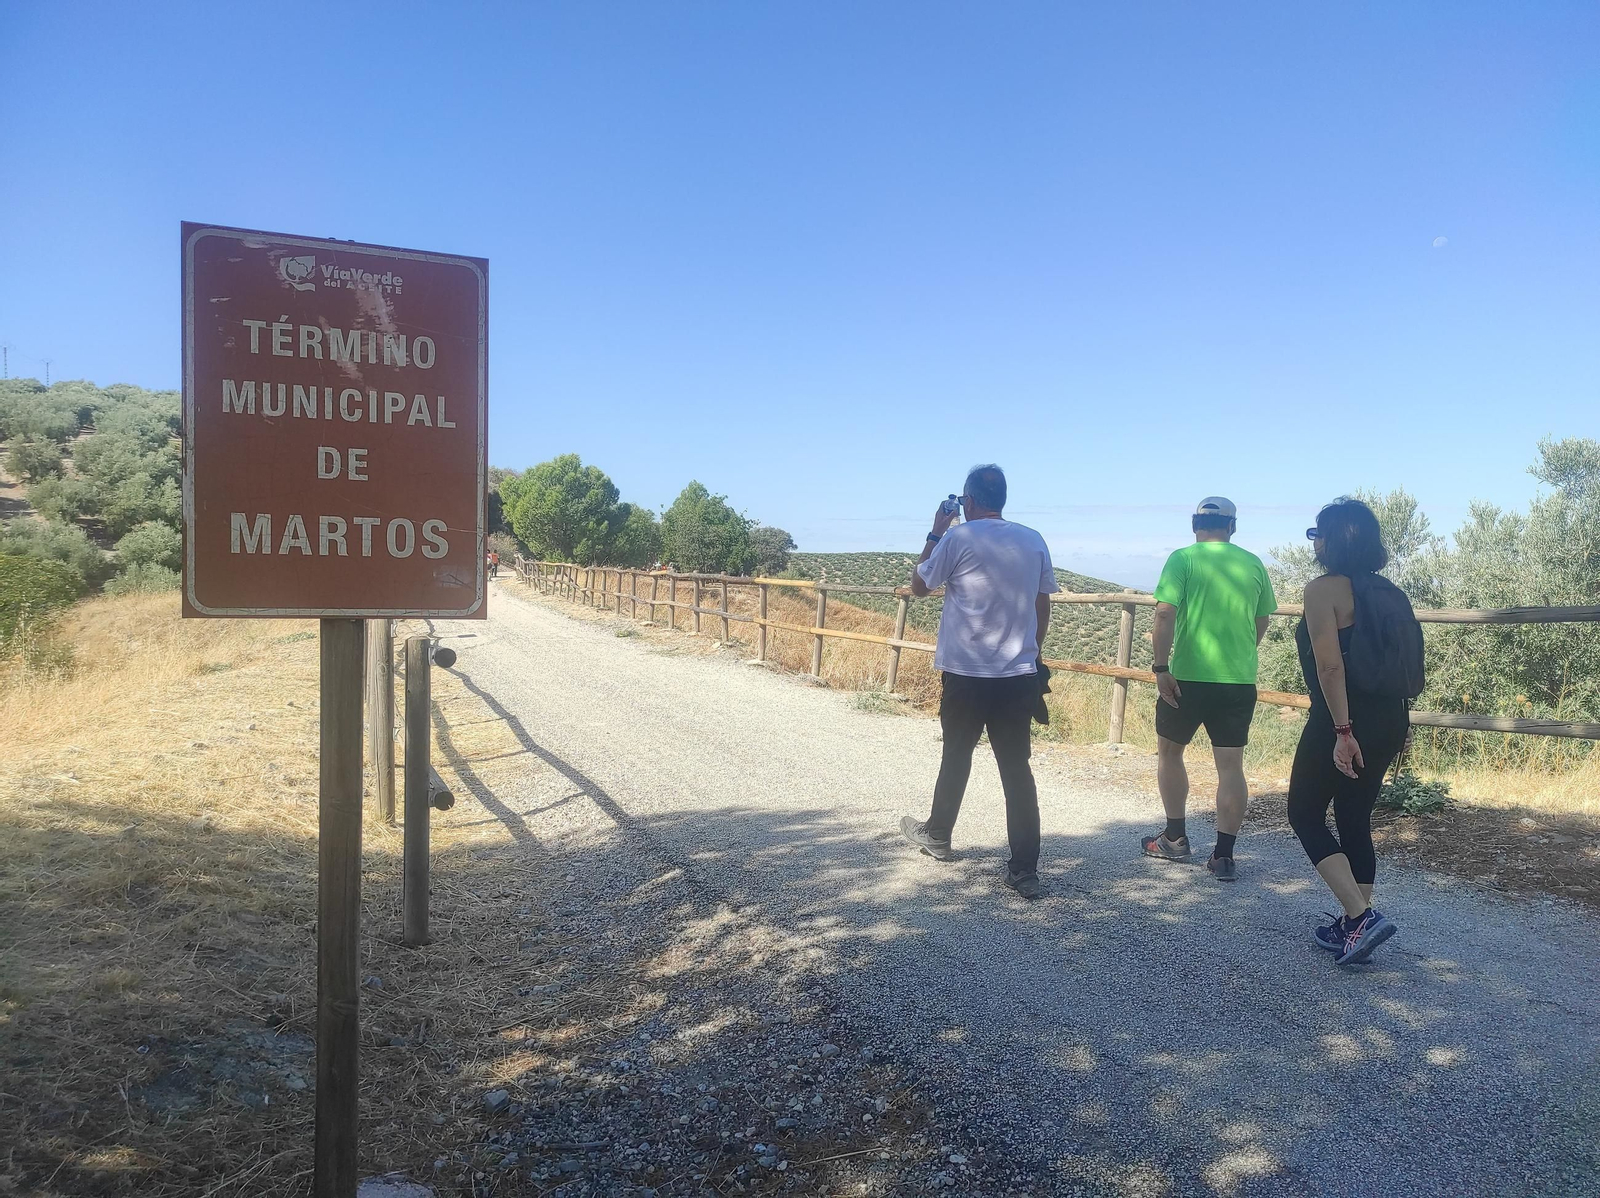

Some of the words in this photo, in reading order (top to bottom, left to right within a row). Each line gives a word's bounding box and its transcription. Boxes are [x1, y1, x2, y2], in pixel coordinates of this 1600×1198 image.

[323, 279, 341, 288] del
[346, 282, 402, 295] ACEITE
[242, 315, 436, 369] TÉRMINO
[222, 378, 456, 429] MUNICIPAL
[317, 446, 369, 481] DE
[230, 512, 449, 560] MARTOS
